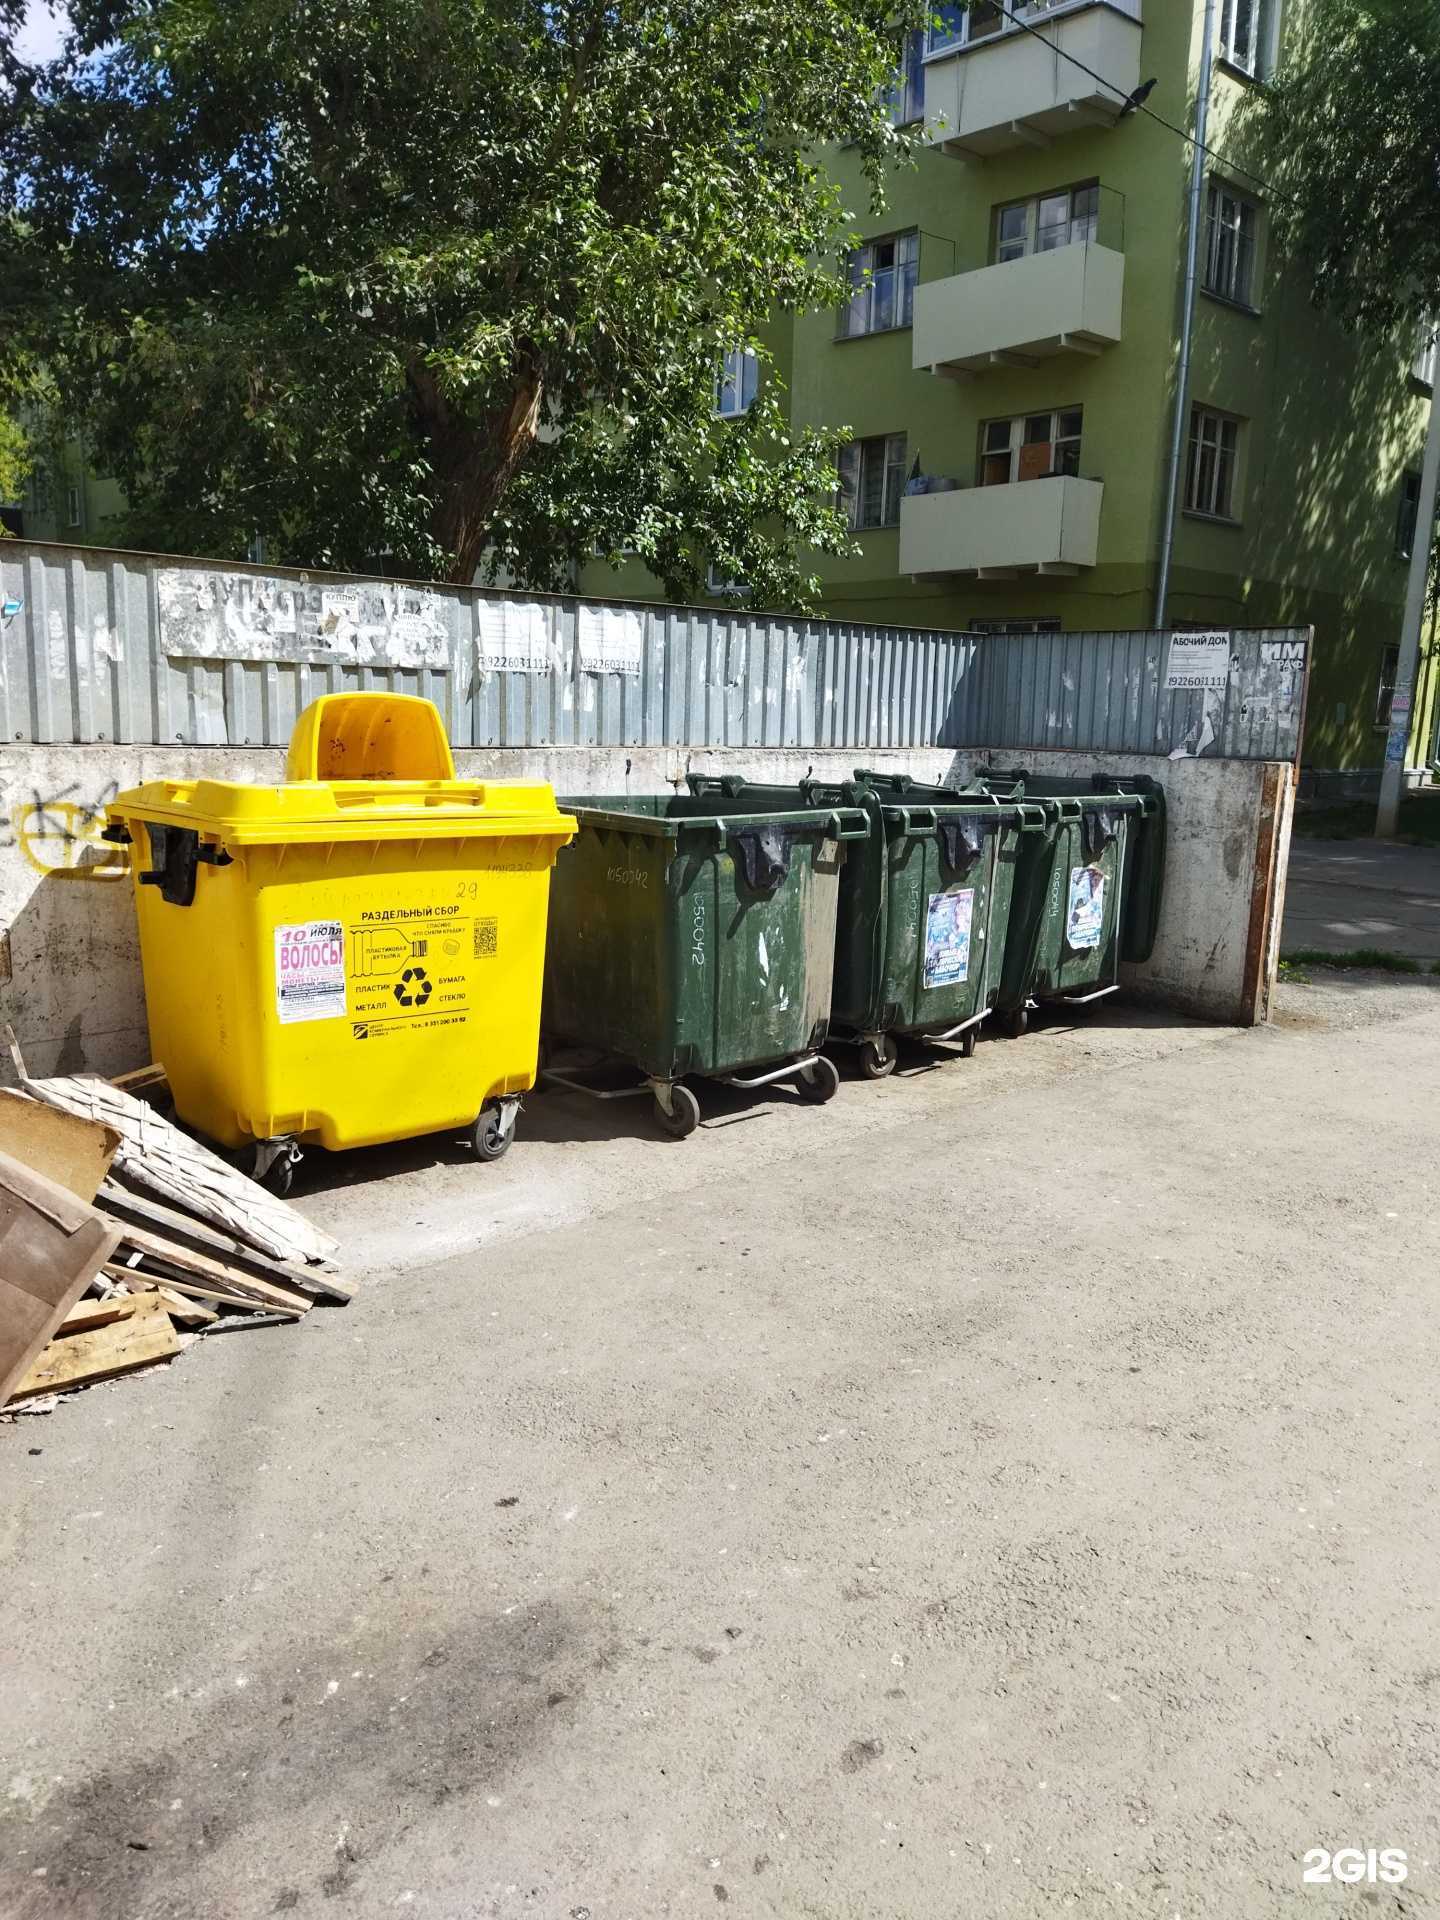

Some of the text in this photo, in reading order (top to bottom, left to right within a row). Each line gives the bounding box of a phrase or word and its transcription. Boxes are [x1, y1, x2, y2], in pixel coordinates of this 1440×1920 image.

[456, 881, 478, 900] 29
[361, 905, 460, 921] РАЗДЕЛЬНЫЙ СБОР
[282, 926, 343, 942] 10 ИЮЛЯ
[280, 941, 343, 970] ВОЛОСЫ
[438, 975, 466, 985] БУМАГА
[355, 983, 391, 993] ПЛАСТИК
[439, 993, 466, 1002] СТЕКЛО
[355, 1002, 387, 1012] МЕТАЛЛ
